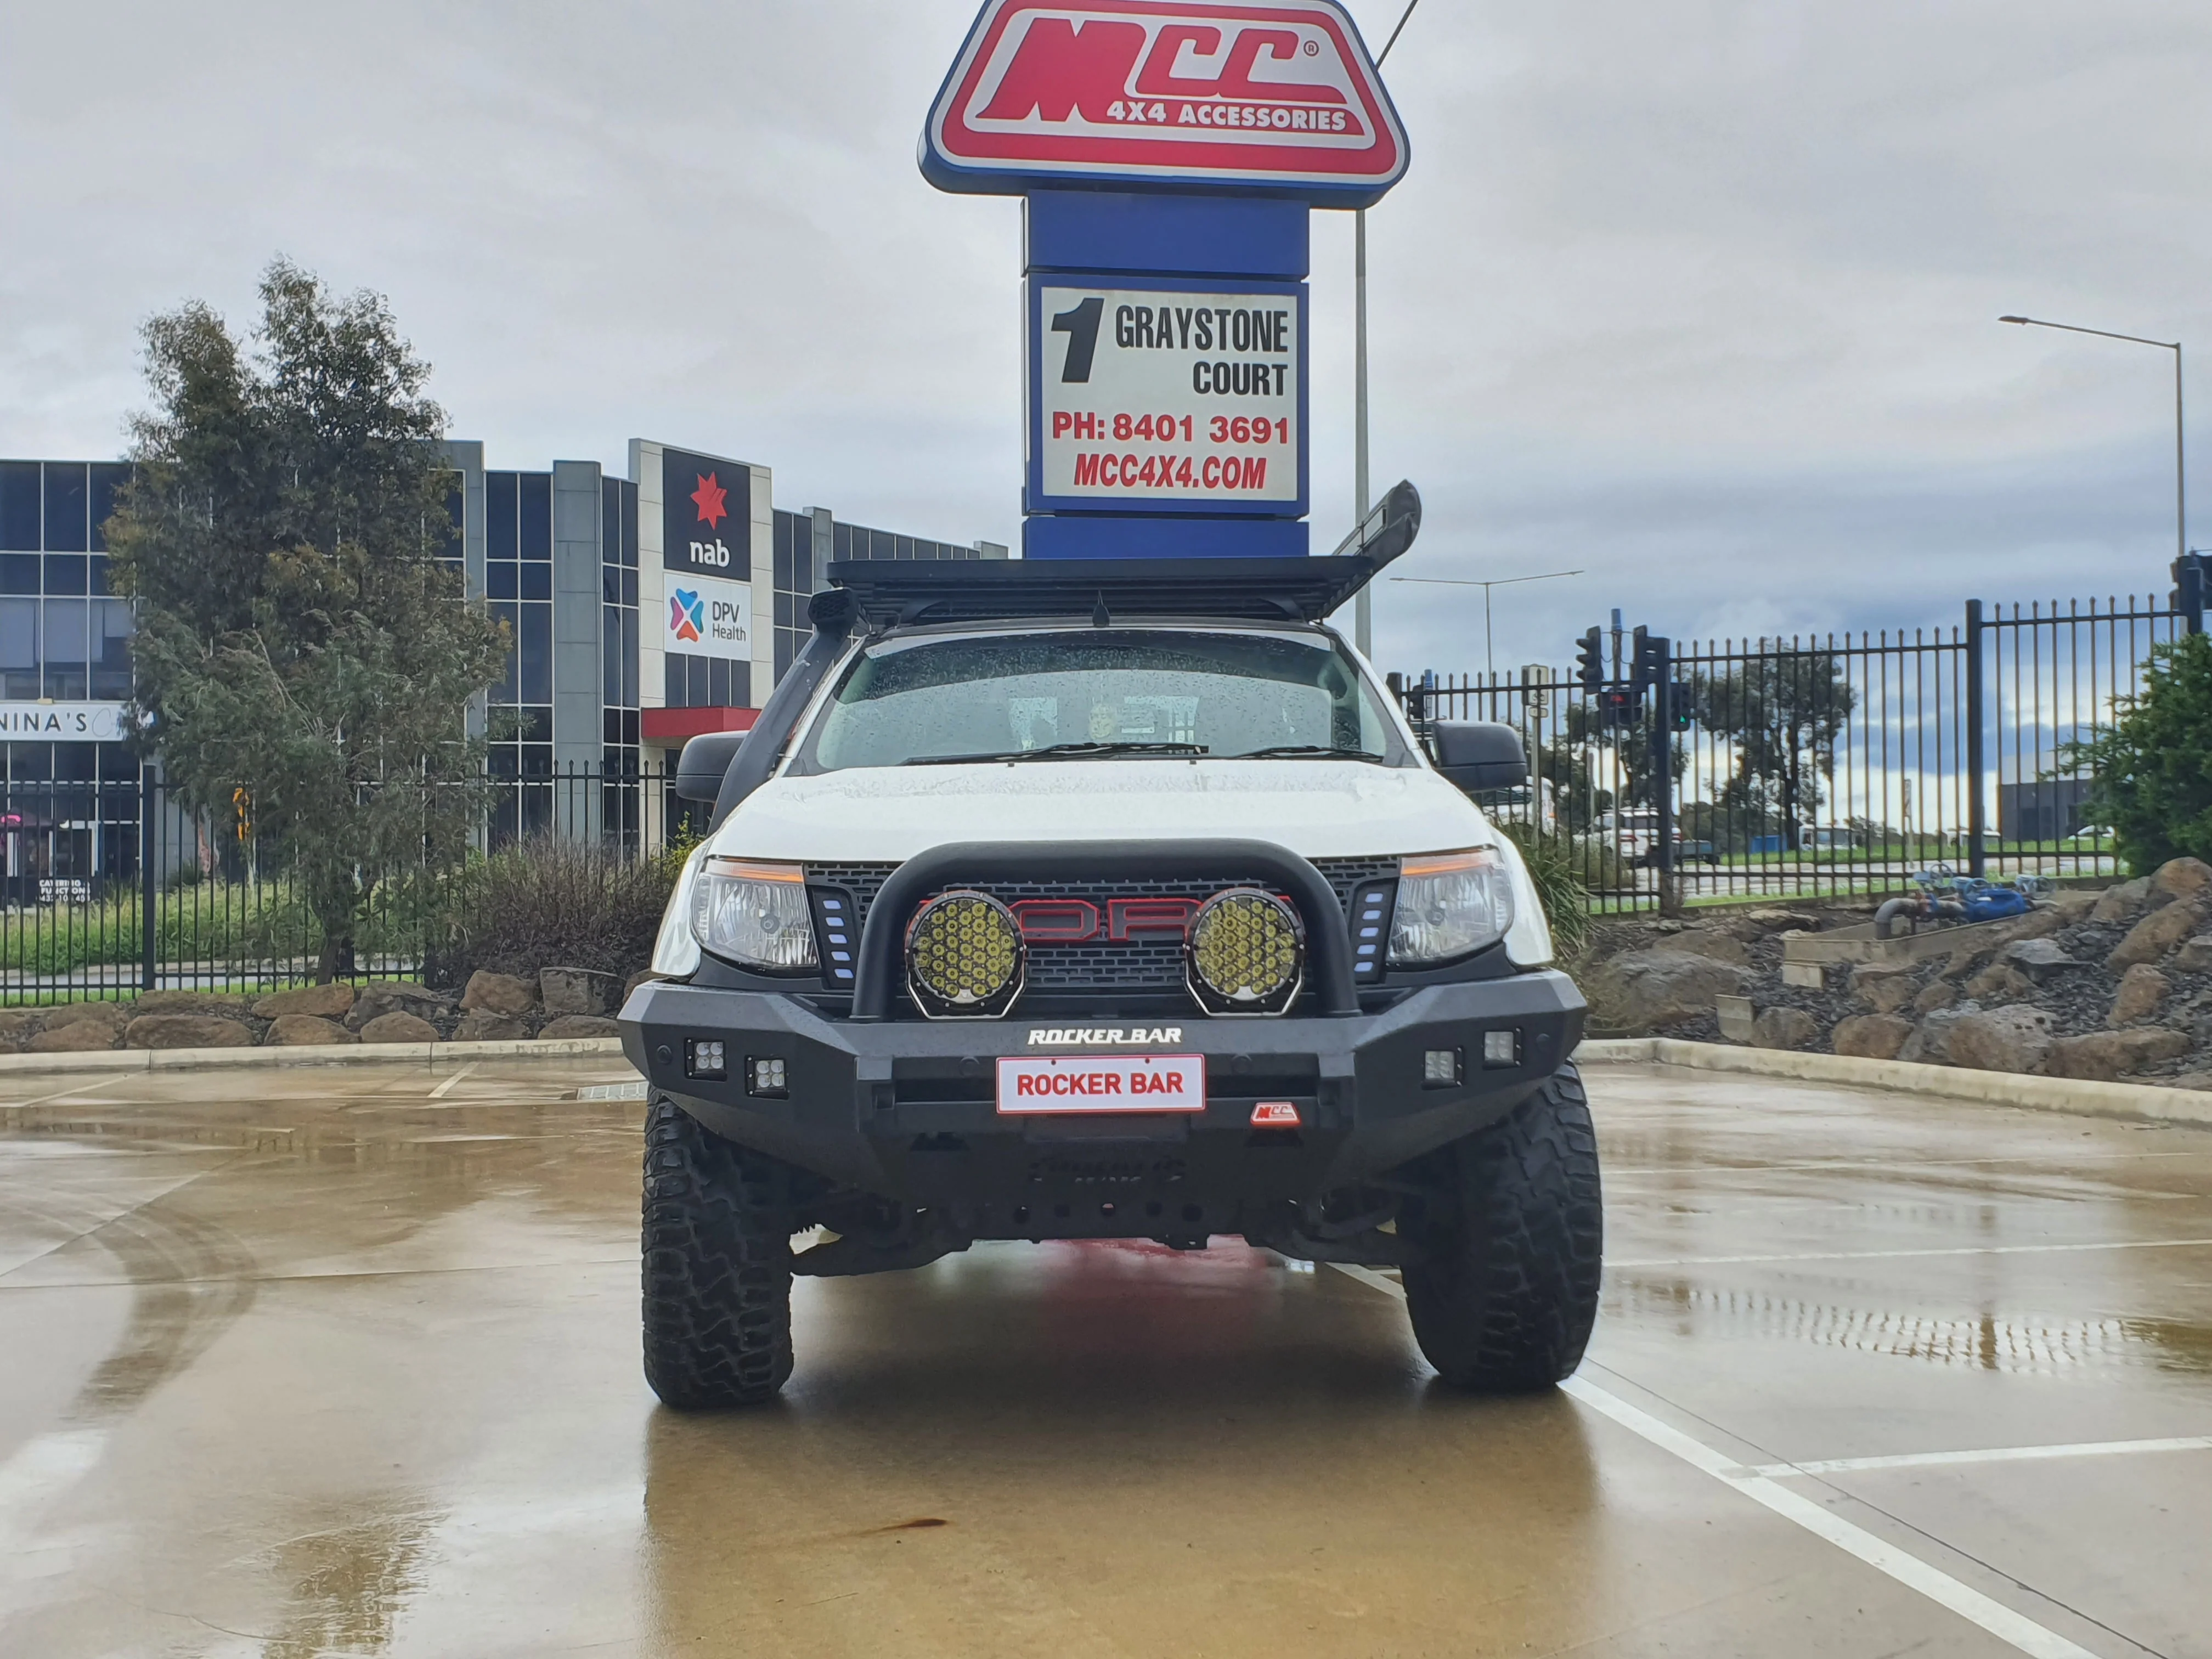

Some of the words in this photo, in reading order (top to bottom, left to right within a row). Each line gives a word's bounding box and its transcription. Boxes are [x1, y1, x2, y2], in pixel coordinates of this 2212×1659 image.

[975, 18, 1348, 123] MCC
[1107, 101, 1167, 123] 4X4
[1177, 104, 1347, 131] ACCESSORIES
[1051, 297, 1105, 383] 1
[1115, 305, 1288, 352] GRAYSTONE
[1192, 361, 1288, 396] COURT
[1052, 411, 1105, 440] PH:
[1112, 413, 1193, 442] 8401
[1209, 416, 1288, 444] 3691
[1073, 453, 1267, 489] MCC4X4.COM
[689, 538, 731, 568] nab
[712, 601, 740, 623] DPV
[712, 623, 747, 642] Health
[1028, 1029, 1124, 1045] ROCKER
[1129, 1028, 1182, 1043] BAR
[1017, 1072, 1122, 1096] ROCKER
[1130, 1071, 1184, 1094] BAR
